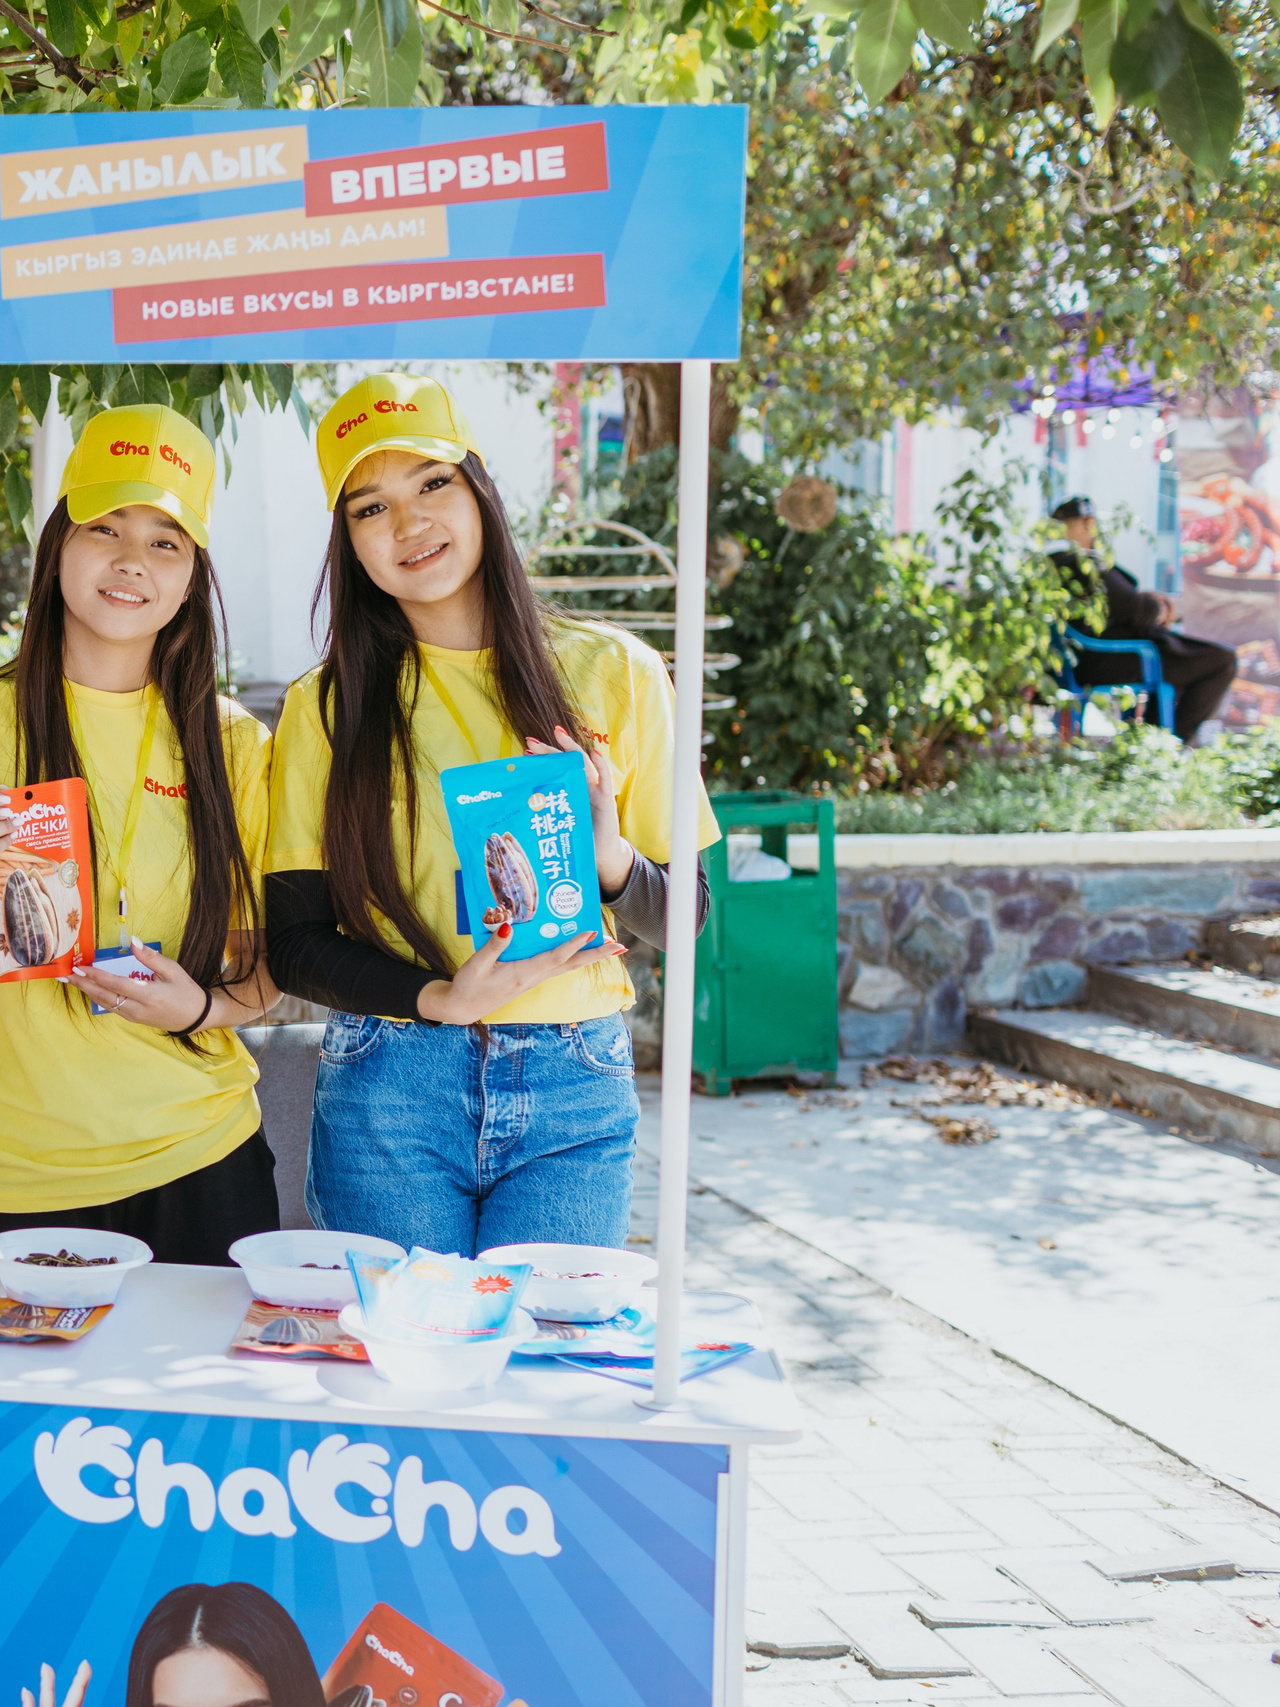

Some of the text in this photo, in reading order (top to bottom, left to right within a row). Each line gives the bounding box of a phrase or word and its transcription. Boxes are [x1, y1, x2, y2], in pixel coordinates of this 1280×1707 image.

[18, 142, 287, 204] ЖАНЫЛЫК
[331, 145, 567, 205] ВПЕРВЫЕ
[15, 247, 123, 278] КЫРГЫЗ
[130, 236, 239, 267] ЭДИНДЕ
[340, 217, 427, 248] ДААМ!
[141, 272, 576, 321] НОВЫЕ ВКУСЫ В КЫРГЫЗСТАНЕ!
[335, 399, 419, 439] Cha Cha
[110, 439, 192, 476] Cha Cha
[456, 790, 503, 805] ChaCha
[34, 1417, 562, 1557] ChaCha
[365, 1633, 415, 1677] ChaCha
